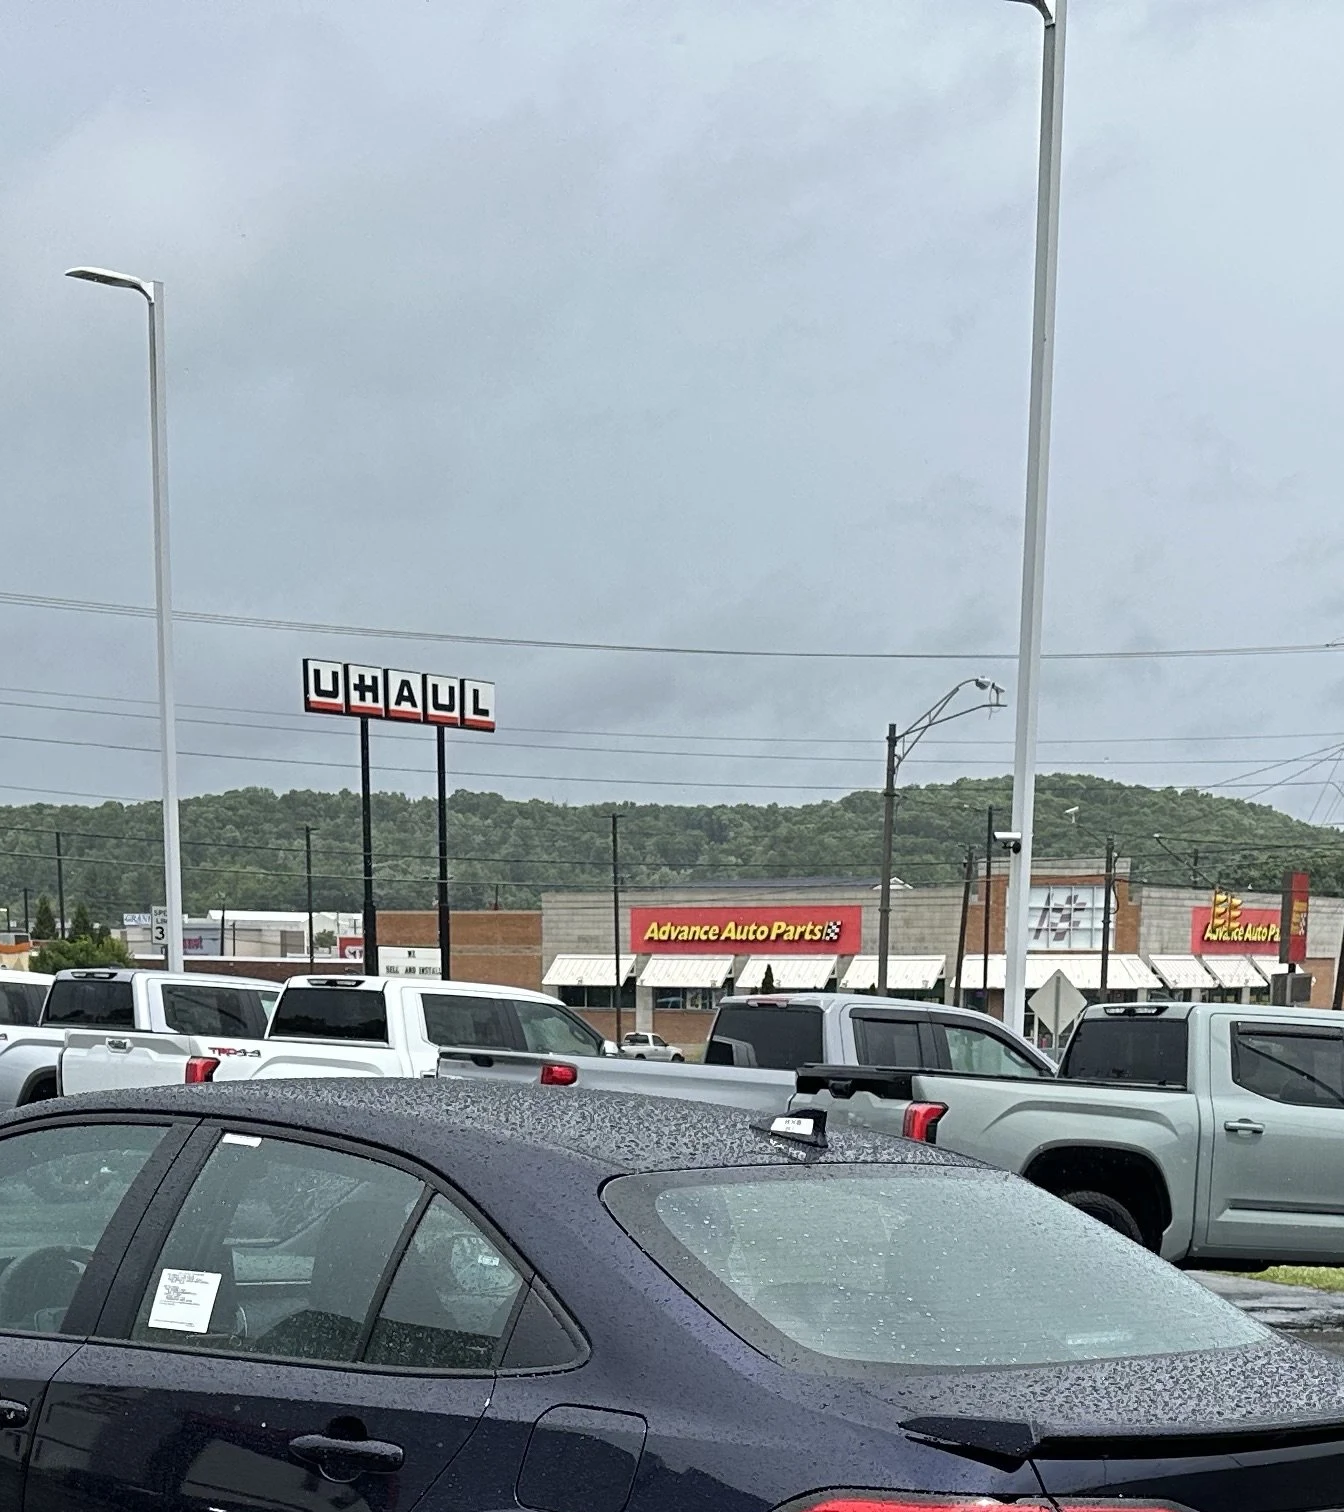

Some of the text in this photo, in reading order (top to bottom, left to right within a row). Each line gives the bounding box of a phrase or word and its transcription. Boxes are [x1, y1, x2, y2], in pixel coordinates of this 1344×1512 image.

[644, 920, 824, 941] Advance Auto Parts
[1243, 922, 1268, 942] Auto
[386, 965, 400, 974] SELL
